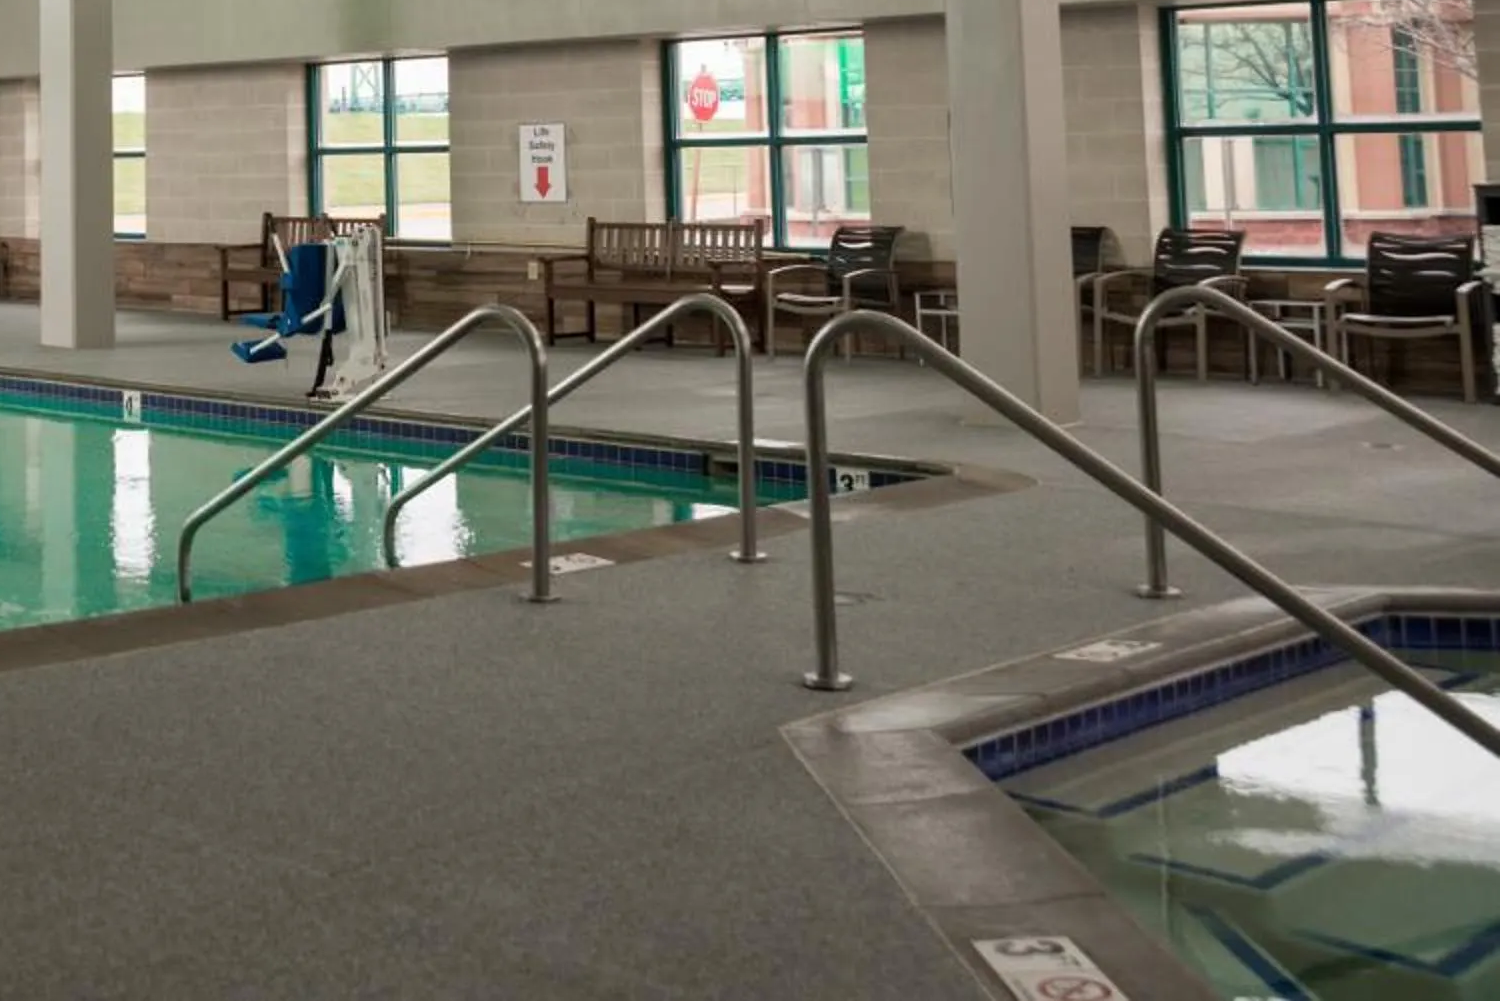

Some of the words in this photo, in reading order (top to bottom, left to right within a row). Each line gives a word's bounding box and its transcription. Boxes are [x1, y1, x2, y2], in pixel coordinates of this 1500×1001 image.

[691, 88, 717, 107] STOP
[529, 141, 555, 152] Safety
[840, 473, 854, 492] 3
[994, 939, 1065, 956] 3
